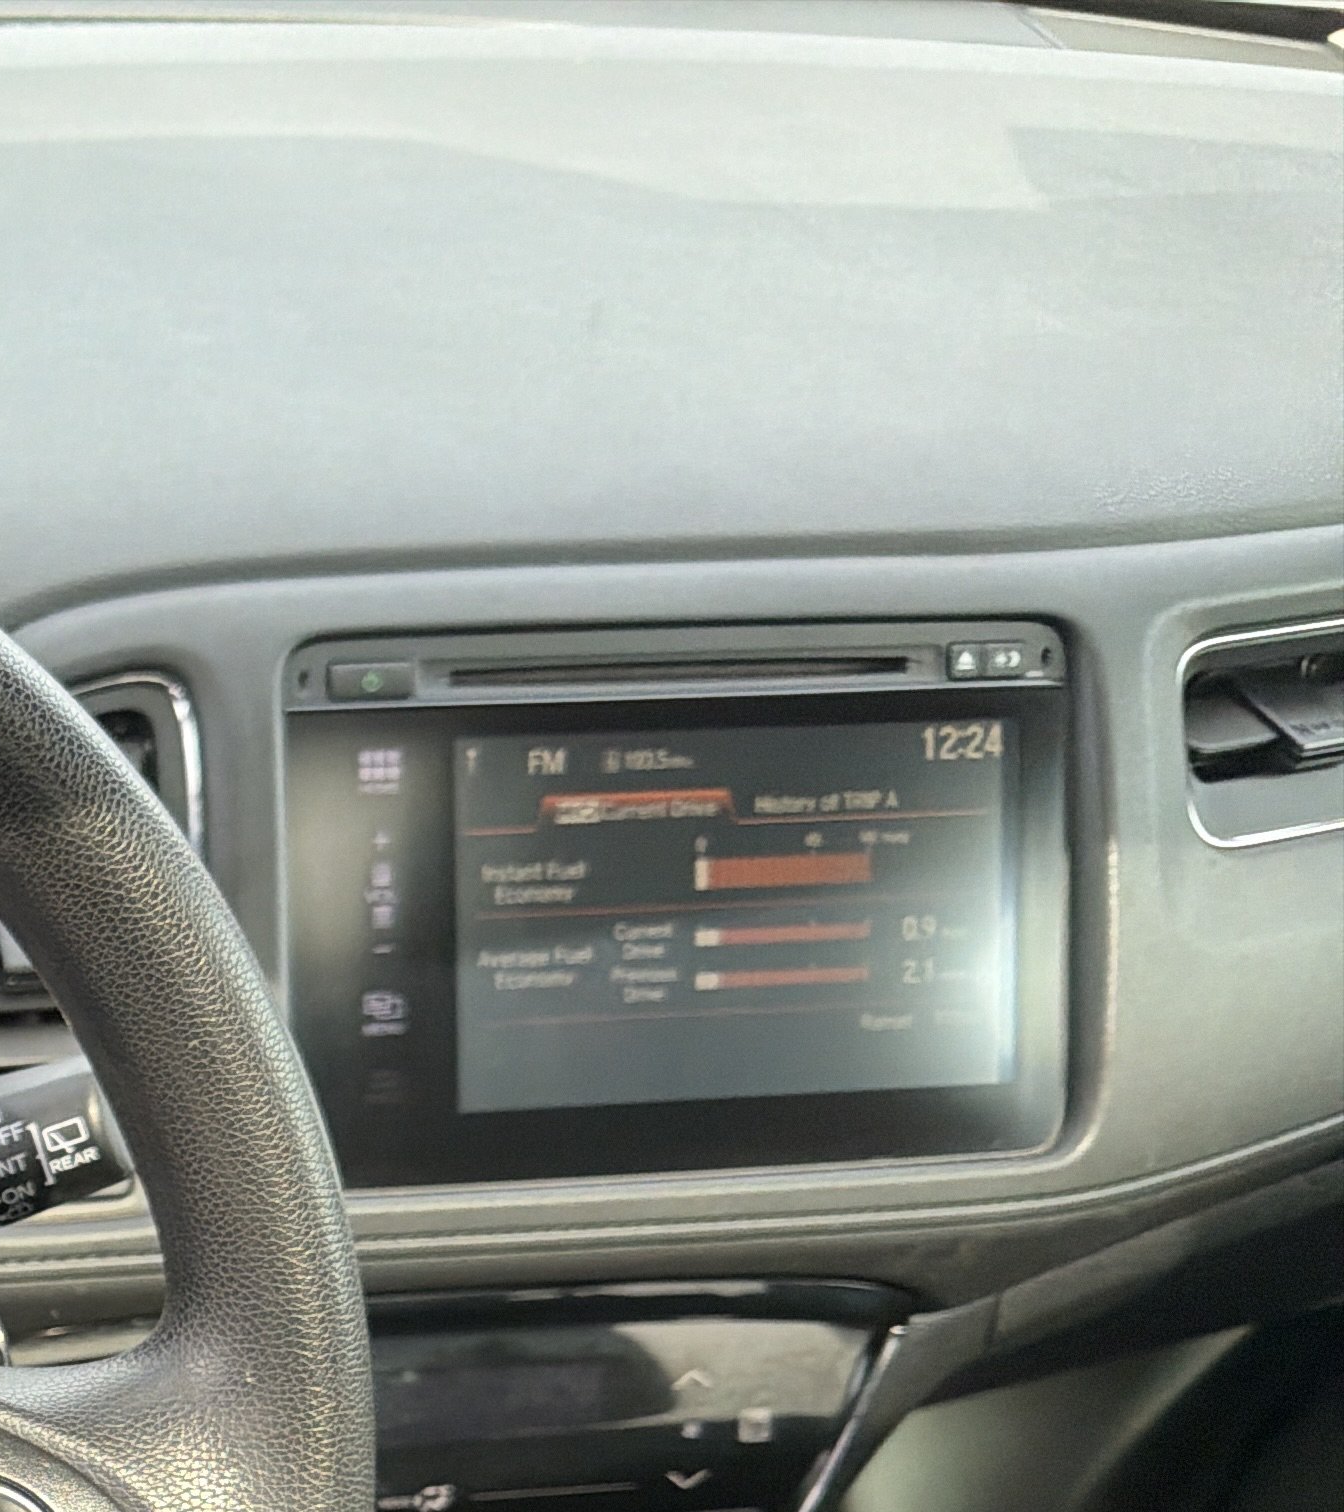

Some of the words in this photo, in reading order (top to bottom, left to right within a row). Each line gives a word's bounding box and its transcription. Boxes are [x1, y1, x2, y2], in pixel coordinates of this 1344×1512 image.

[923, 721, 1003, 760] 12:24
[528, 746, 567, 775] FM
[49, 1146, 102, 1175] REAR
[1, 1180, 37, 1205] ON
